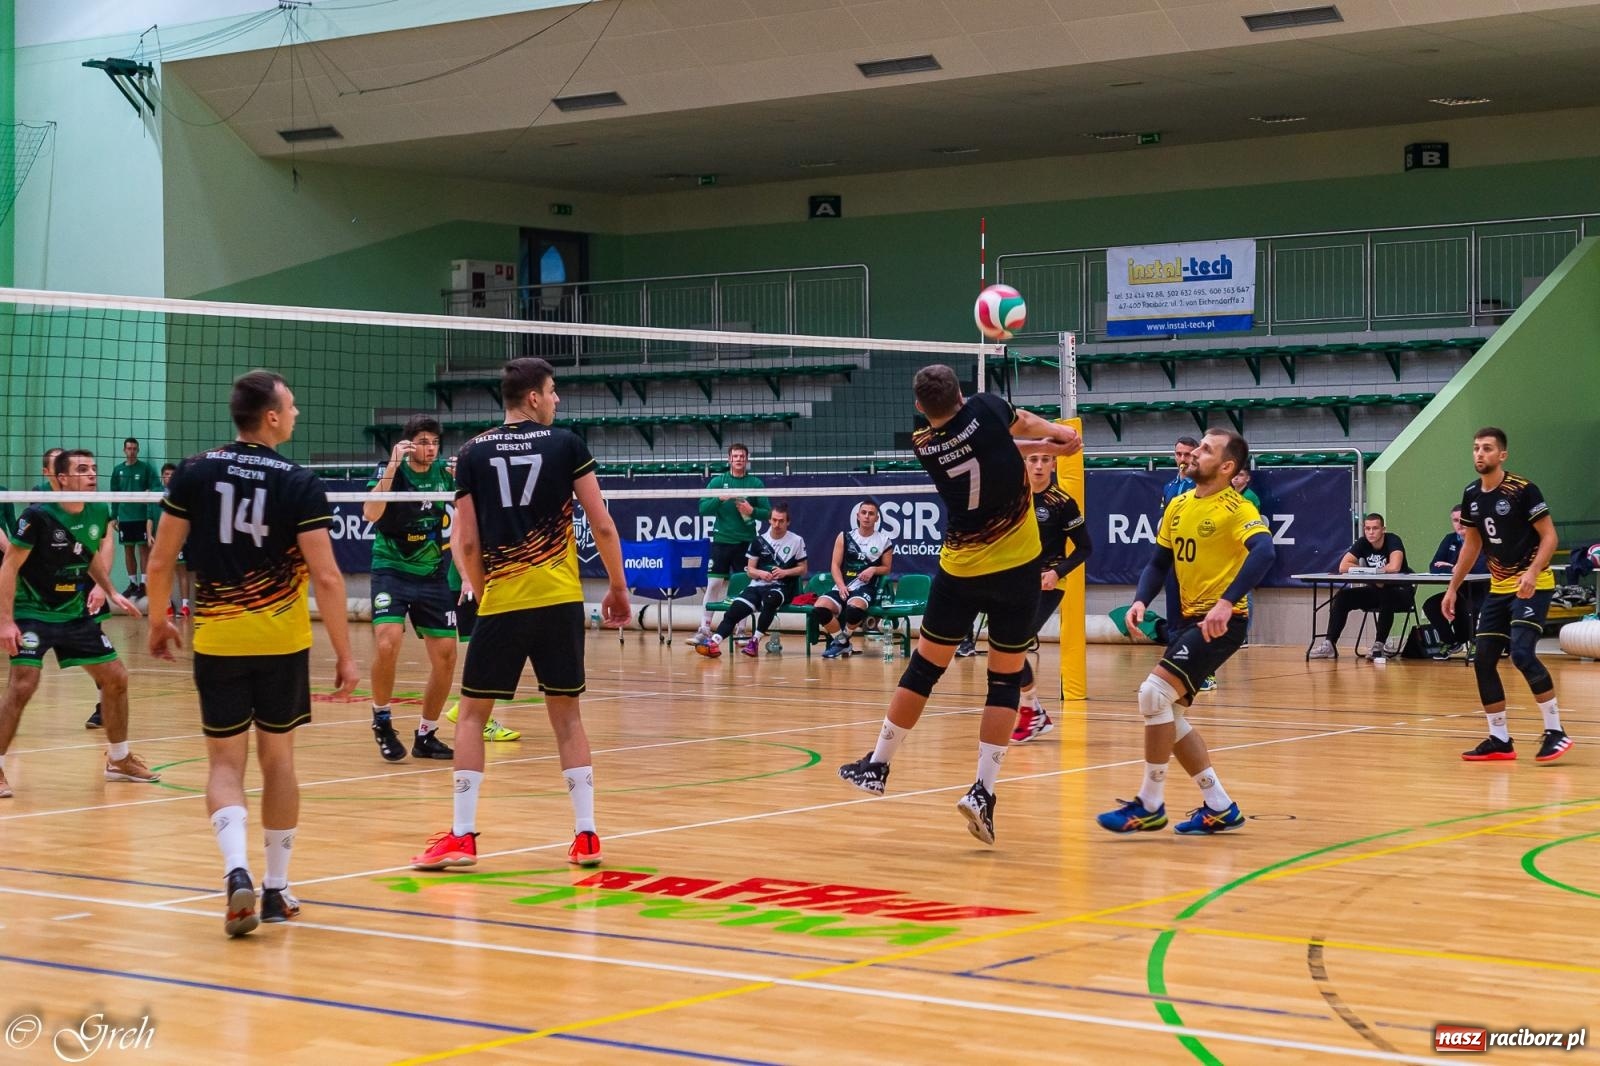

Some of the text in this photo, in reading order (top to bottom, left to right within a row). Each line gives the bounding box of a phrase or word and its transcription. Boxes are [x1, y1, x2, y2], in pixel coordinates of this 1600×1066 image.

[1422, 152, 1441, 166] B
[816, 203, 836, 215] A
[1127, 254, 1233, 283] instal-tech
[1180, 289, 1192, 297] 632
[1146, 320, 1215, 331] www.instal-tech.pl
[475, 433, 504, 444] TALENT
[941, 417, 981, 452] SFERAWENT
[495, 442, 533, 451] CIESZYN
[937, 443, 974, 466] CIESZYN
[236, 454, 295, 472] SFERAWENT
[489, 453, 544, 508] 17
[945, 456, 981, 511] 7
[214, 481, 270, 548] 14
[851, 501, 943, 541] OSiR
[1484, 516, 1497, 536] 6
[72, 542, 83, 555] 4
[891, 542, 942, 556] ACIBÓRZ
[1174, 536, 1197, 563] 20
[624, 556, 664, 569] molten
[100, 634, 113, 649] 4
